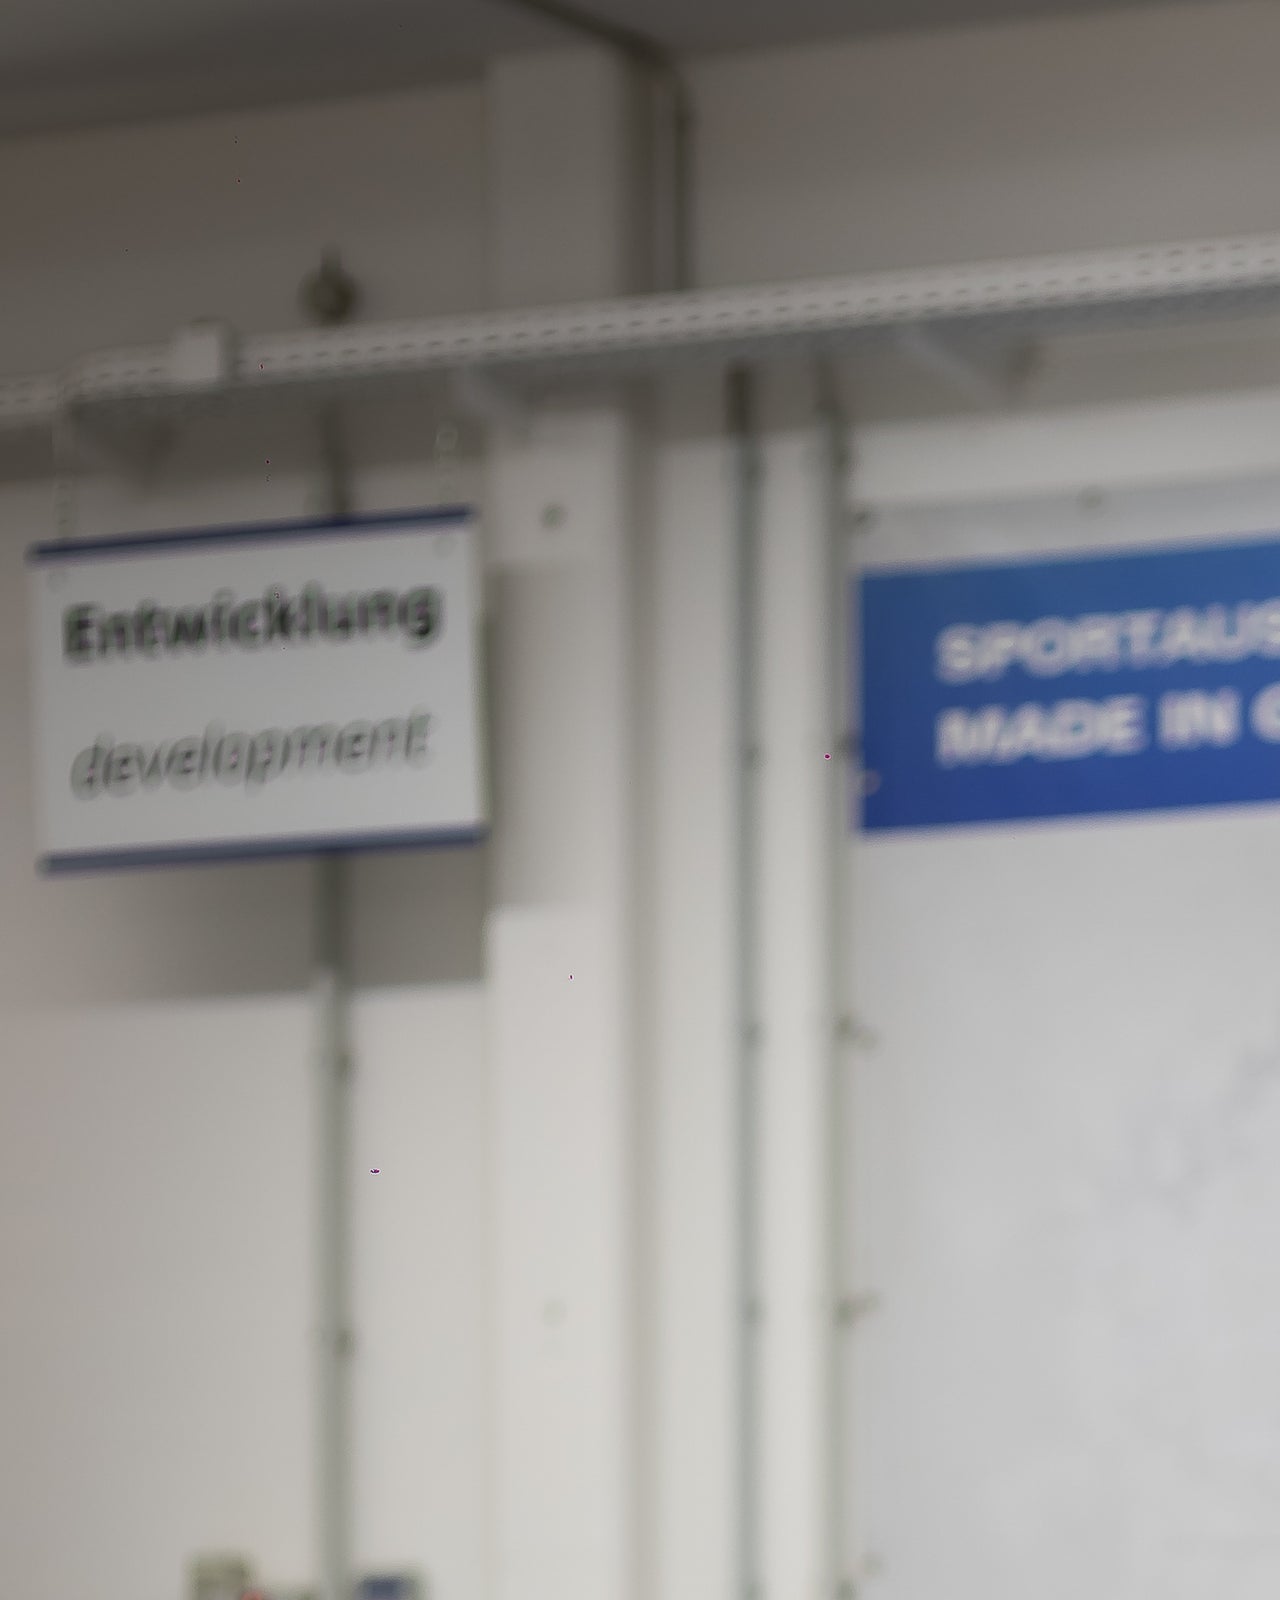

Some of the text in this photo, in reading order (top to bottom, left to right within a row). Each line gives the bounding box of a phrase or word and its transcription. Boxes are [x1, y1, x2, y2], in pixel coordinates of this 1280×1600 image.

[63, 584, 444, 667] Entwicklung
[70, 703, 436, 800] development
[934, 690, 1142, 769] MADE
[1158, 684, 1241, 750] IN
